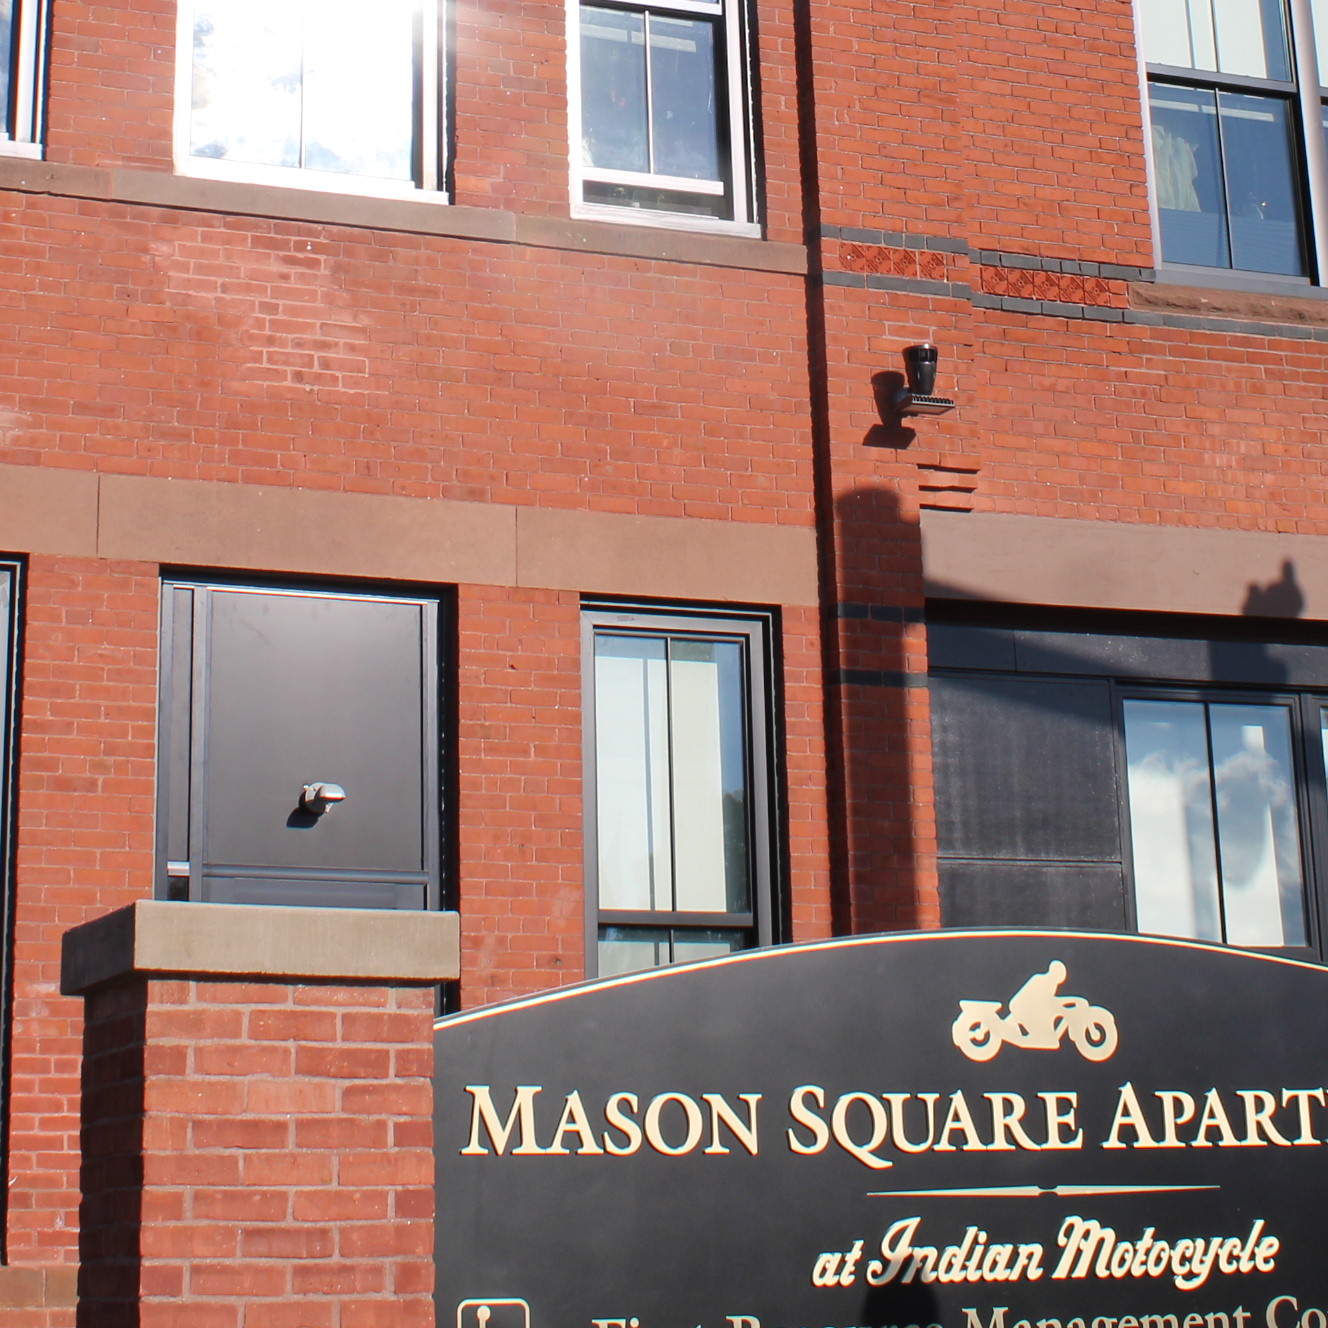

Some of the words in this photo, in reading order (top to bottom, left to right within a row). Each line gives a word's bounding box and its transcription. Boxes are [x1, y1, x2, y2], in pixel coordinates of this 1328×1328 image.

[460, 1084, 763, 1156] MASON
[786, 1084, 1084, 1169] SQUARE
[811, 1239, 864, 1286] at
[866, 1216, 1043, 1286] Indian
[1052, 1215, 1280, 1290] Motocycle
